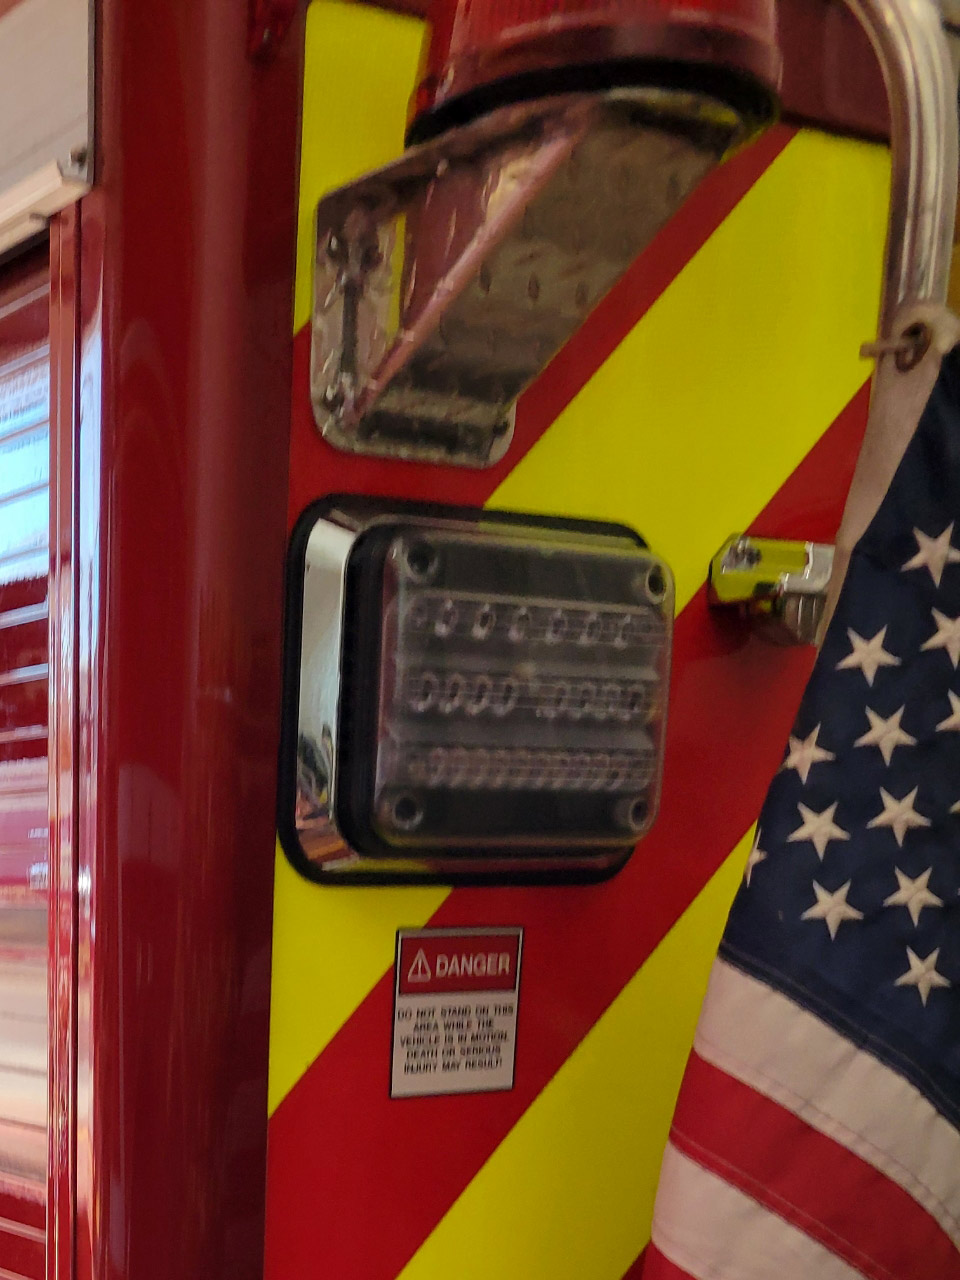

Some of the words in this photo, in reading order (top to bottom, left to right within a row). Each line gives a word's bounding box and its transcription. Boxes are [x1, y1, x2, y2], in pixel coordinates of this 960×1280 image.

[436, 952, 510, 978] DANGER
[397, 1006, 412, 1021] DO
[416, 1006, 436, 1019] NOT
[441, 1004, 471, 1019] STAND
[475, 1003, 489, 1017] ON
[494, 1002, 514, 1016] THIS
[413, 1020, 439, 1033] AREA
[443, 1019, 472, 1031] WHILE
[477, 1017, 494, 1031] THE
[400, 1034, 440, 1048] VEHICLE
[444, 1034, 453, 1046] IS
[457, 1032, 467, 1045] IN
[406, 1048, 438, 1060] DEATH
[442, 1047, 455, 1058] OR
[460, 1045, 501, 1057] SERIOUS
[404, 1061, 437, 1075] INJURY
[442, 1059, 461, 1072] MAY
